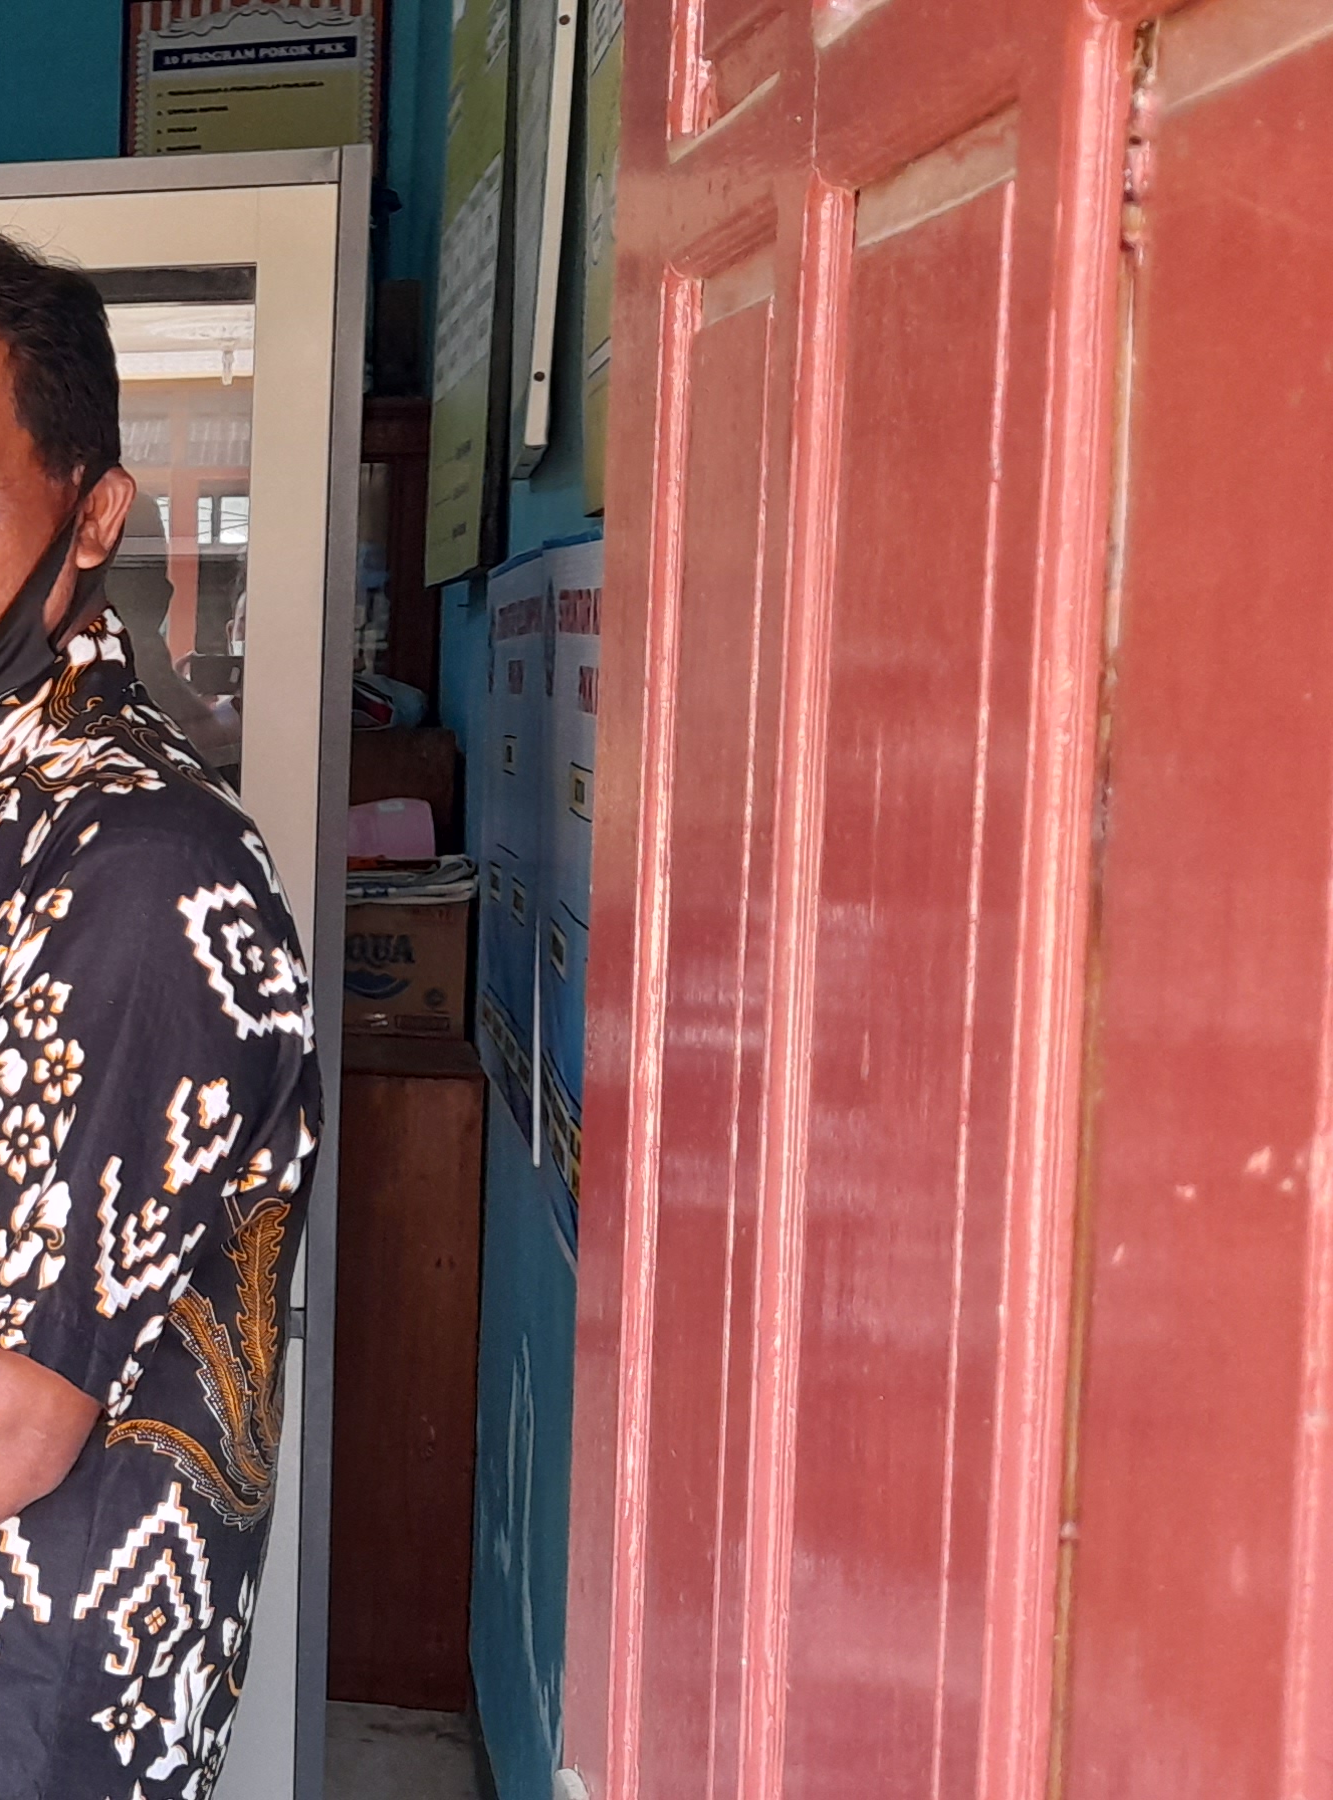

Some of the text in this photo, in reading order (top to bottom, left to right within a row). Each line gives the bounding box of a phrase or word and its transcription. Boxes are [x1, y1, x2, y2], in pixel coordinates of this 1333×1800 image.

[183, 49, 256, 64] PROGRAM
[259, 44, 312, 60] POKOK
[314, 42, 348, 55] PKK
[345, 932, 416, 968] QUA
